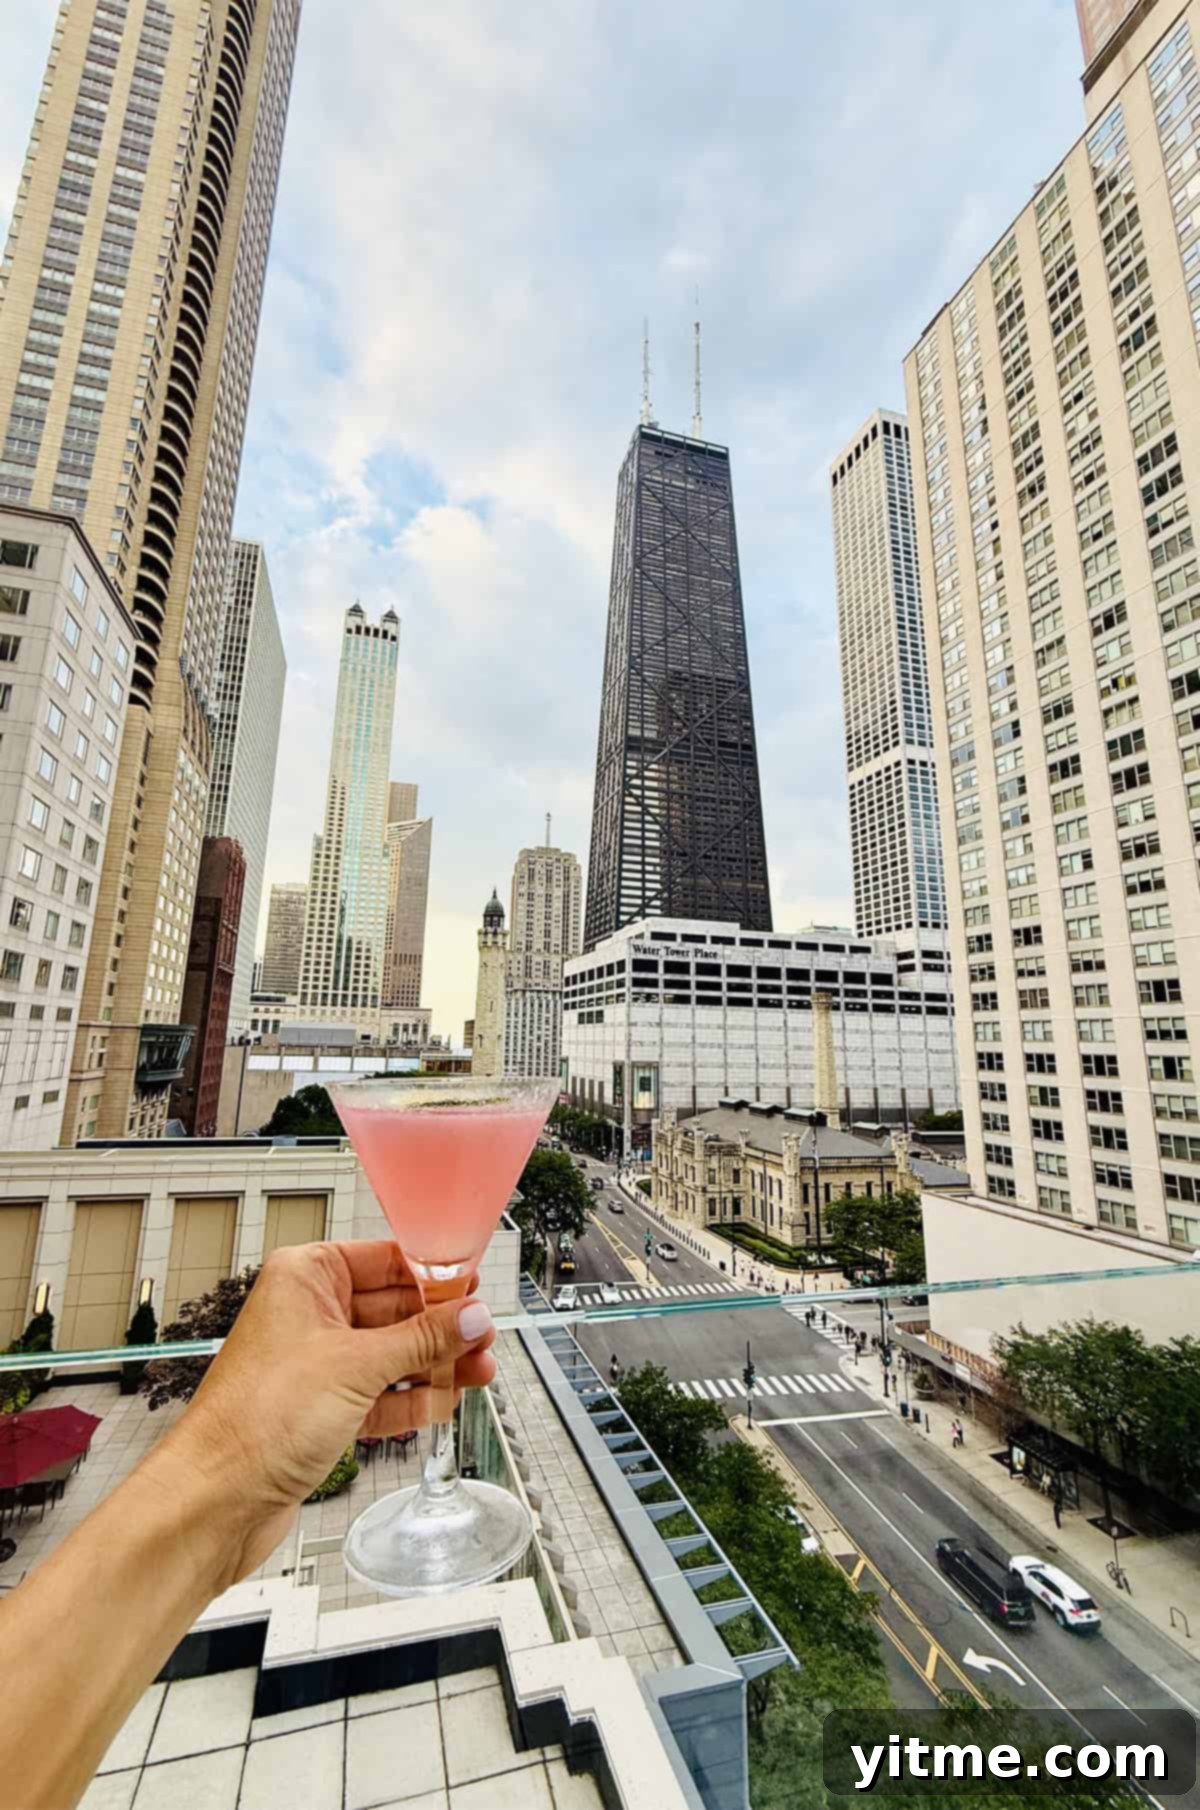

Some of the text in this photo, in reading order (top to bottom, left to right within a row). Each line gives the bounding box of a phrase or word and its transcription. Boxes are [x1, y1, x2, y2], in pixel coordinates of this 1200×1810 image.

[632, 944, 718, 959] Water Tower Place
